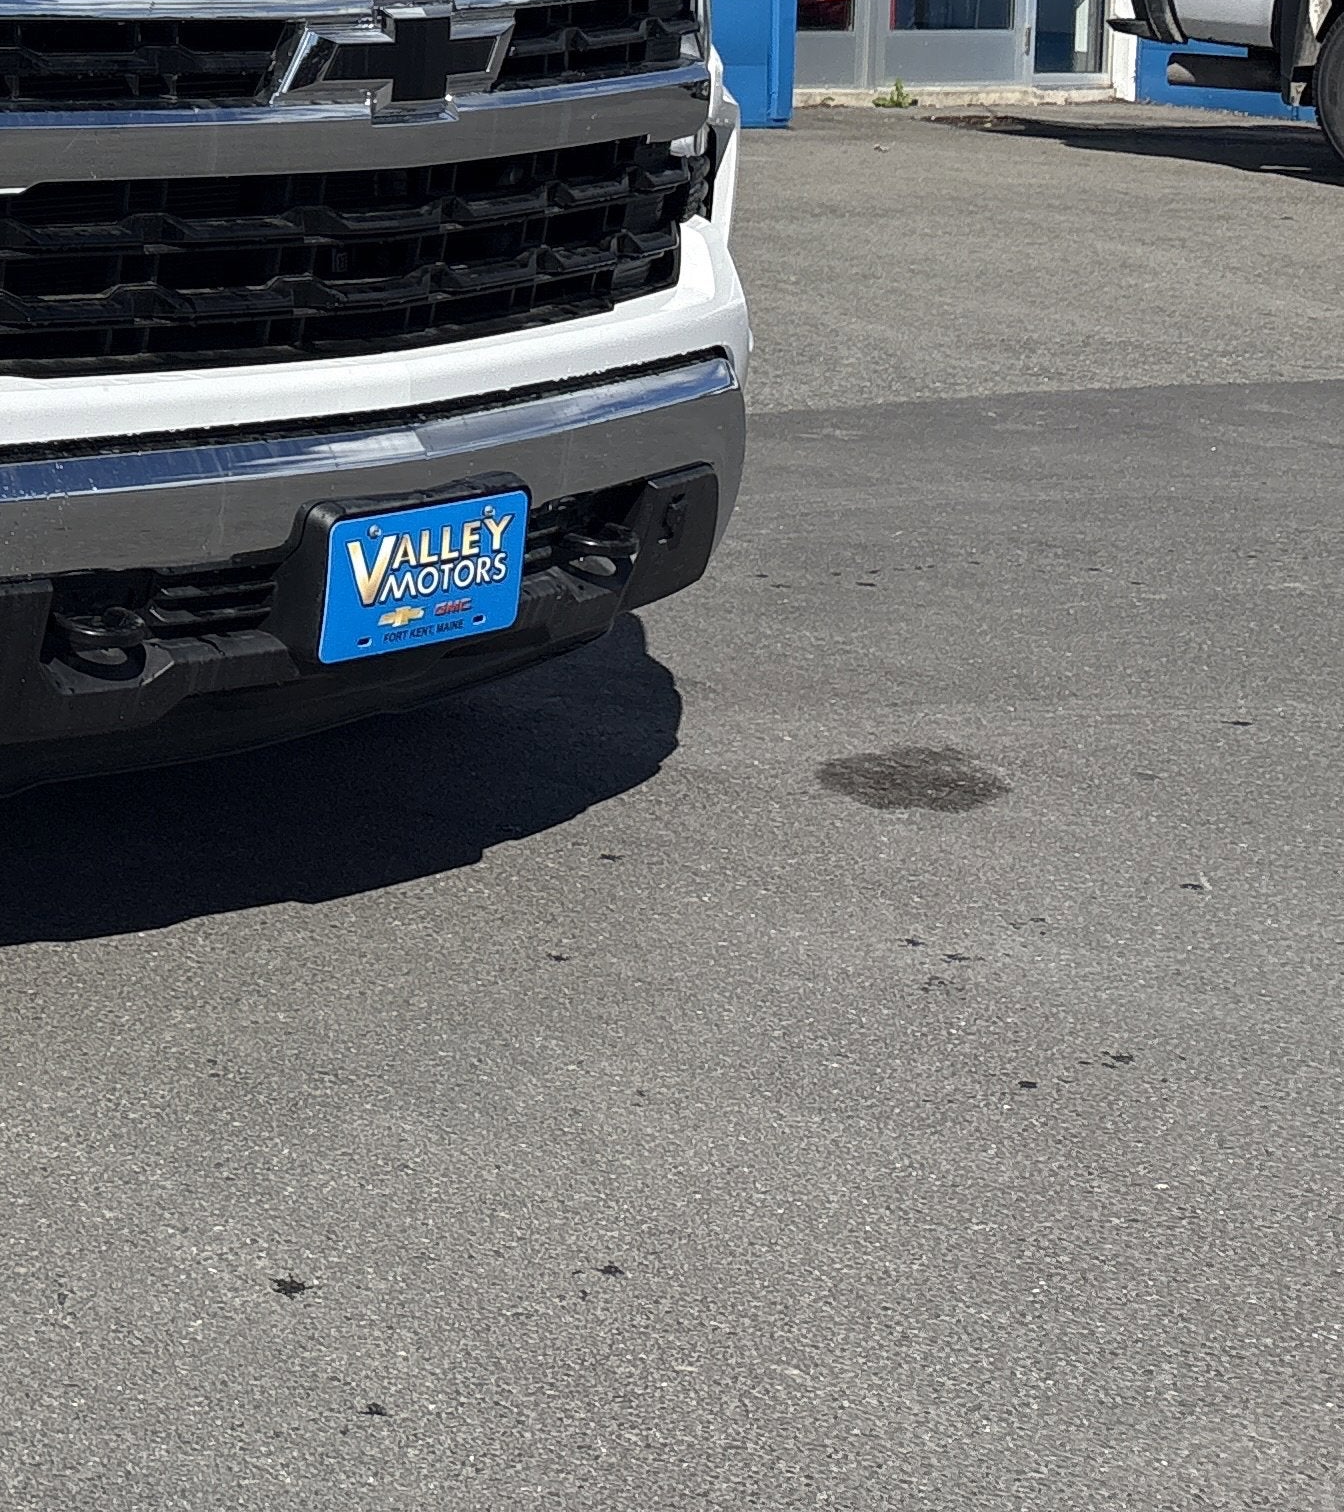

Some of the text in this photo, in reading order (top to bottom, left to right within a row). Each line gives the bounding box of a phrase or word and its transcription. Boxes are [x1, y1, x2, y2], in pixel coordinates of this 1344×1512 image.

[345, 512, 516, 607] VALLEY
[379, 552, 508, 603] MOTORS
[434, 597, 472, 617] GMC
[436, 619, 464, 633] MAINE
